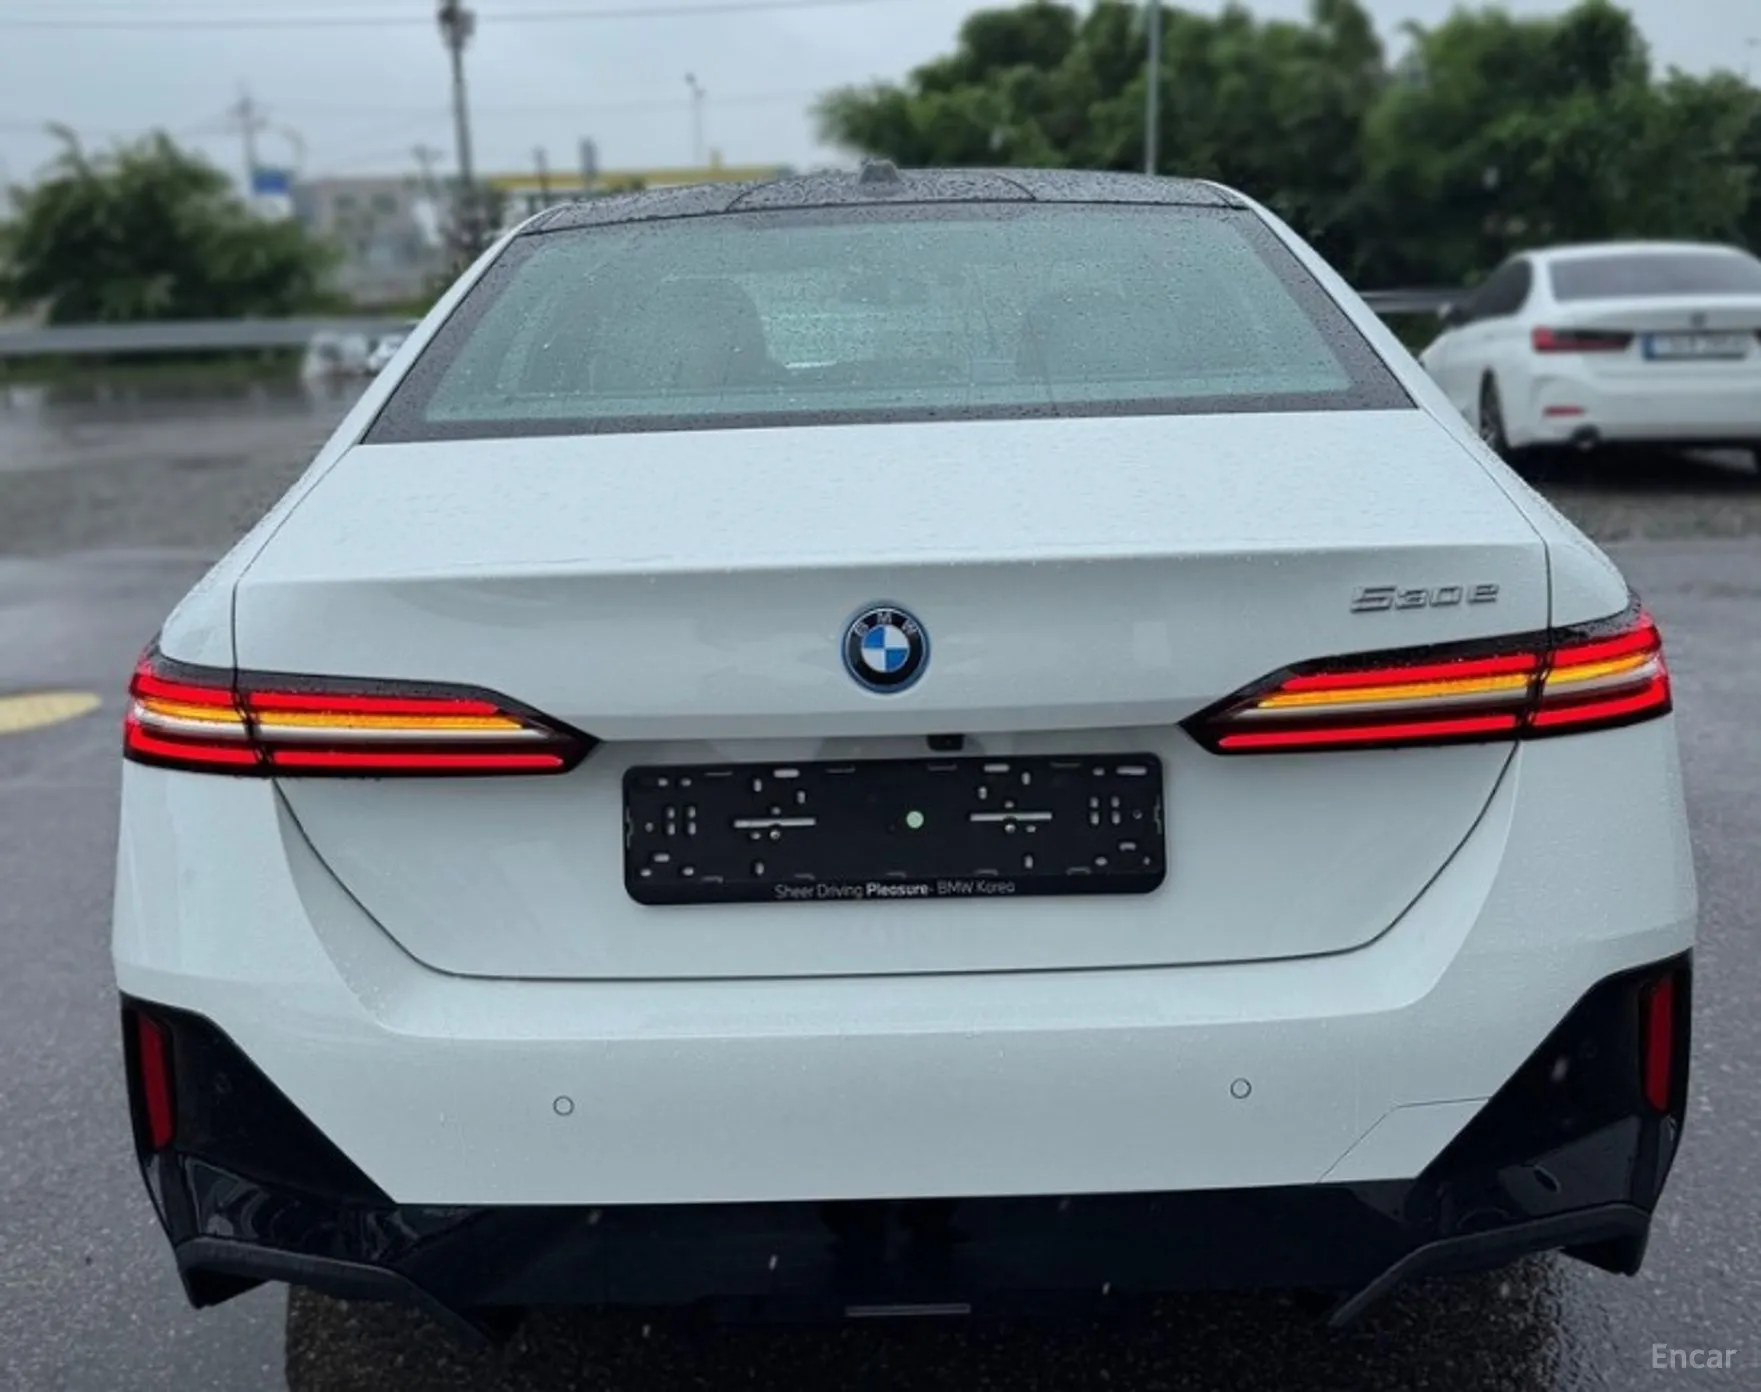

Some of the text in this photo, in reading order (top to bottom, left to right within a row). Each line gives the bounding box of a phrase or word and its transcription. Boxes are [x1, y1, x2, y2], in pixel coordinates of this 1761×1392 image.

[1350, 583, 1499, 613] 530e
[852, 610, 919, 637] BMW
[774, 883, 814, 899] Sheer
[816, 882, 863, 900] Driving
[937, 879, 973, 895] BMW
[977, 879, 1016, 894] Korea
